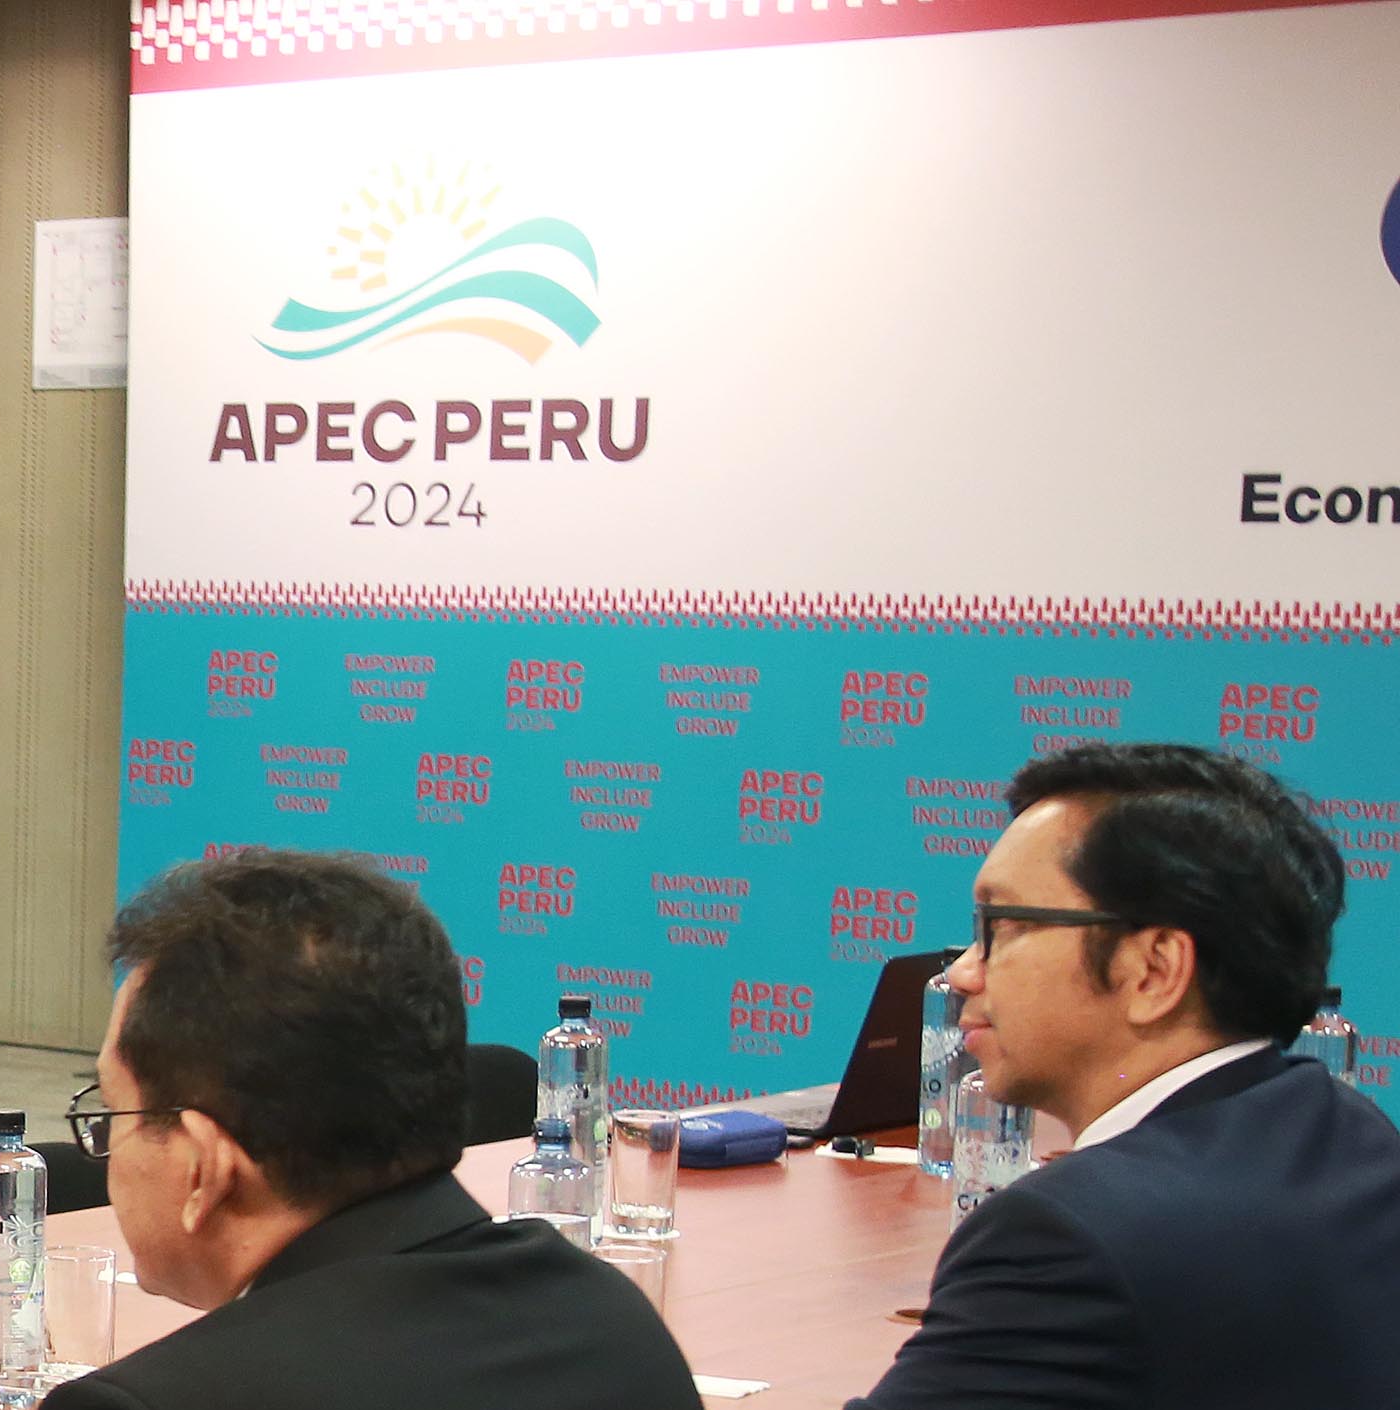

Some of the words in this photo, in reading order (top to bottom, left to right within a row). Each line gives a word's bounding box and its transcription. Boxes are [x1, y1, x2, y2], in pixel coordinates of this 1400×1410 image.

[209, 399, 417, 463] APEC
[433, 397, 650, 463] PERU
[349, 481, 488, 527] 2024
[208, 650, 277, 675] APEC
[344, 654, 436, 674] EMPOWER
[507, 659, 584, 686] APEC
[659, 664, 760, 686] EMPOWER
[207, 674, 276, 699] PERU
[351, 680, 428, 699] INCLUDE
[841, 671, 928, 699] APEC
[1014, 675, 1132, 699] EMPOWER
[506, 685, 581, 712] PERU
[666, 690, 753, 713] INCLUDE
[1220, 683, 1320, 713] APEC
[360, 704, 416, 724] GROW
[840, 698, 925, 727] PERU
[1020, 705, 1122, 728] INCLUDE
[675, 717, 738, 737] GROW
[1219, 712, 1316, 743] PERU
[128, 739, 195, 763] APEC
[260, 745, 348, 765] EMPOWER
[1032, 733, 1105, 756] GRO
[128, 762, 193, 788] PERU
[417, 753, 491, 780] APEC
[564, 760, 661, 782] EMPOWER
[266, 769, 341, 790] INCLUDE
[416, 778, 489, 805] PERU
[740, 769, 823, 798] APEC
[275, 794, 330, 813] GROW
[570, 786, 653, 808] INCLUDE
[580, 812, 641, 832] GROW
[739, 796, 820, 825] PERU
[499, 863, 576, 892] APEC
[651, 872, 750, 898] EMPOWER
[498, 888, 573, 917] PERU
[657, 899, 742, 923] INCLUDE
[831, 887, 917, 916] APEC
[666, 926, 730, 946] GROW
[830, 913, 915, 944] PERU
[557, 965, 653, 989] EMPOWER
[731, 980, 813, 1011] APEC
[730, 1006, 811, 1038] PERU
